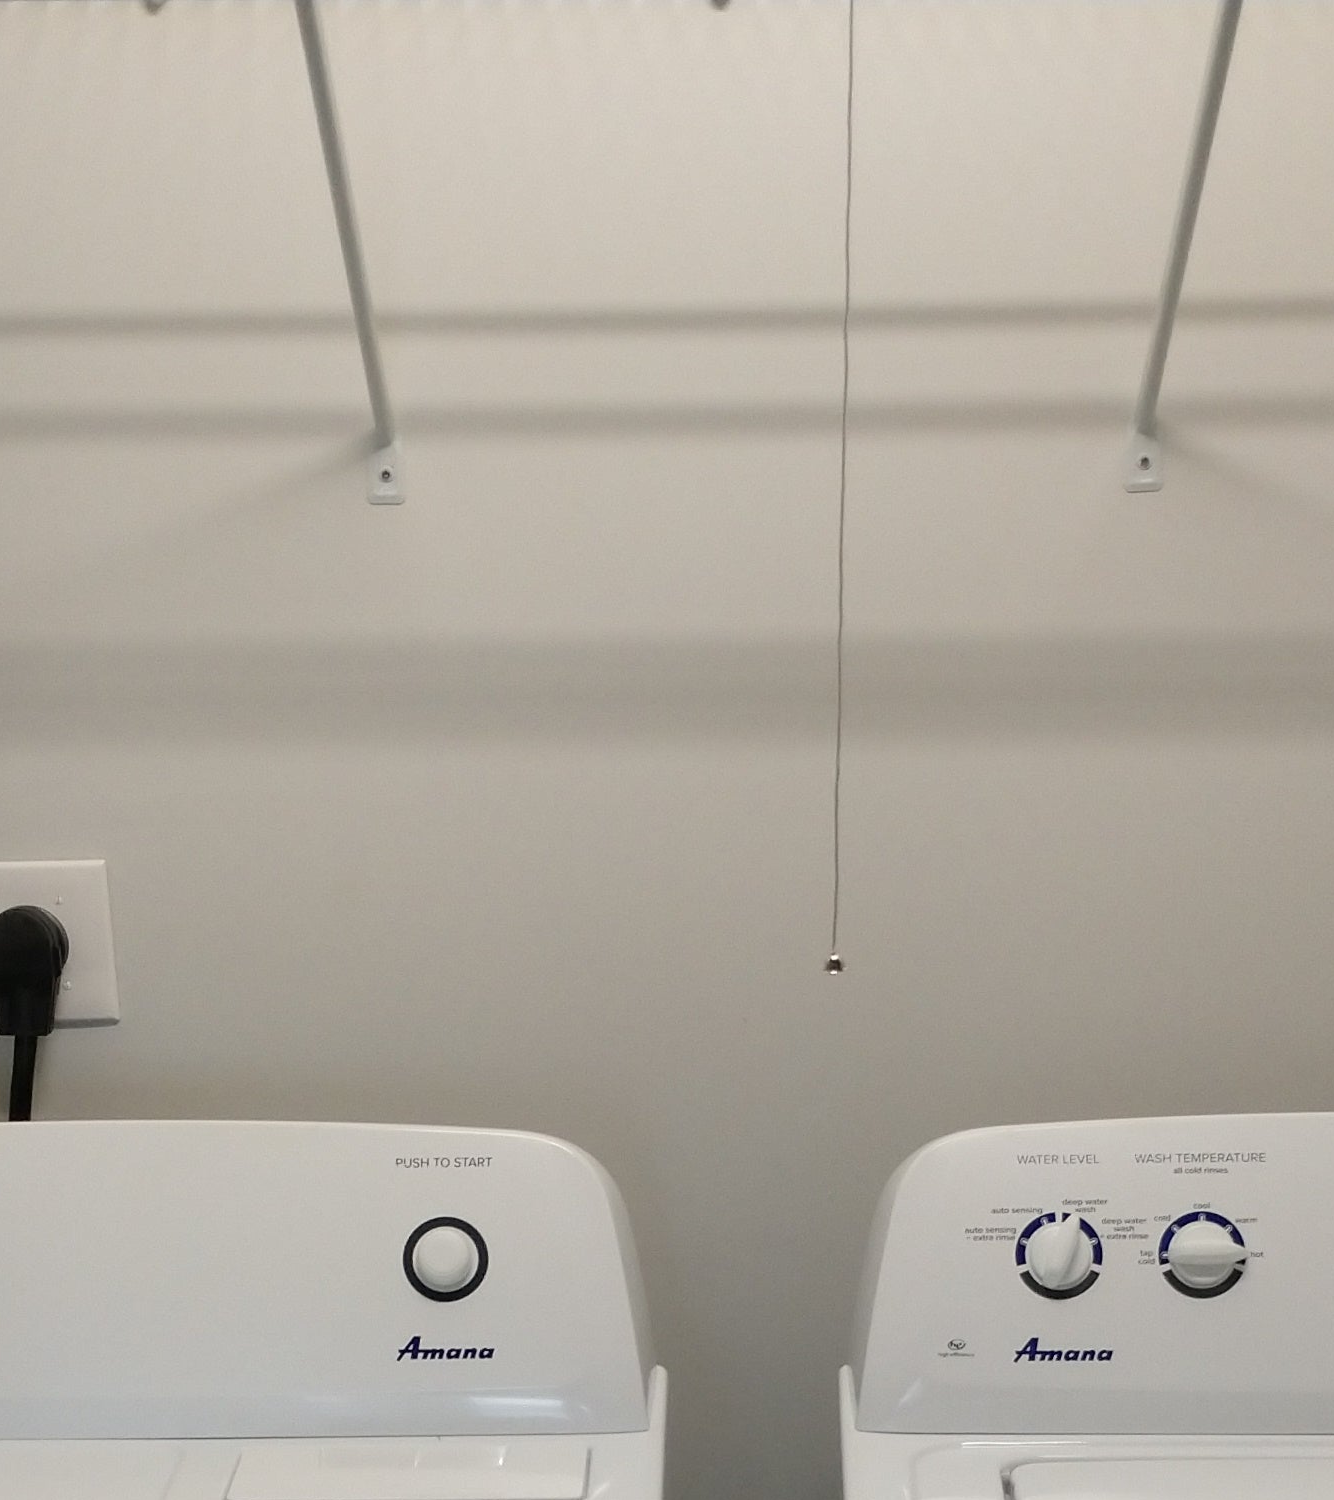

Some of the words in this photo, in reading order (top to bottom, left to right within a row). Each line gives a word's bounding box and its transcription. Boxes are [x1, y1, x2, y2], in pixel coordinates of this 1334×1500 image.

[1016, 1154, 1059, 1165] WATER
[1062, 1154, 1100, 1165] LEVEL
[1134, 1153, 1172, 1164] WASH
[1175, 1151, 1267, 1163] TEMPERATURE
[395, 1157, 430, 1169] PUSH
[434, 1157, 451, 1168] TO
[453, 1156, 493, 1168] START
[1061, 1199, 1083, 1207] deep
[1085, 1198, 1109, 1206] water
[1011, 1206, 1044, 1215] sensing
[1101, 1217, 1123, 1226] deep
[1124, 1216, 1148, 1225] water
[1153, 1214, 1172, 1222] cold
[964, 1226, 984, 1234] auto
[985, 1226, 1017, 1235] sensing
[972, 1233, 994, 1241] extra
[1139, 1249, 1154, 1258] tap
[396, 1336, 495, 1361] Amana
[1013, 1337, 1114, 1362] Amana
